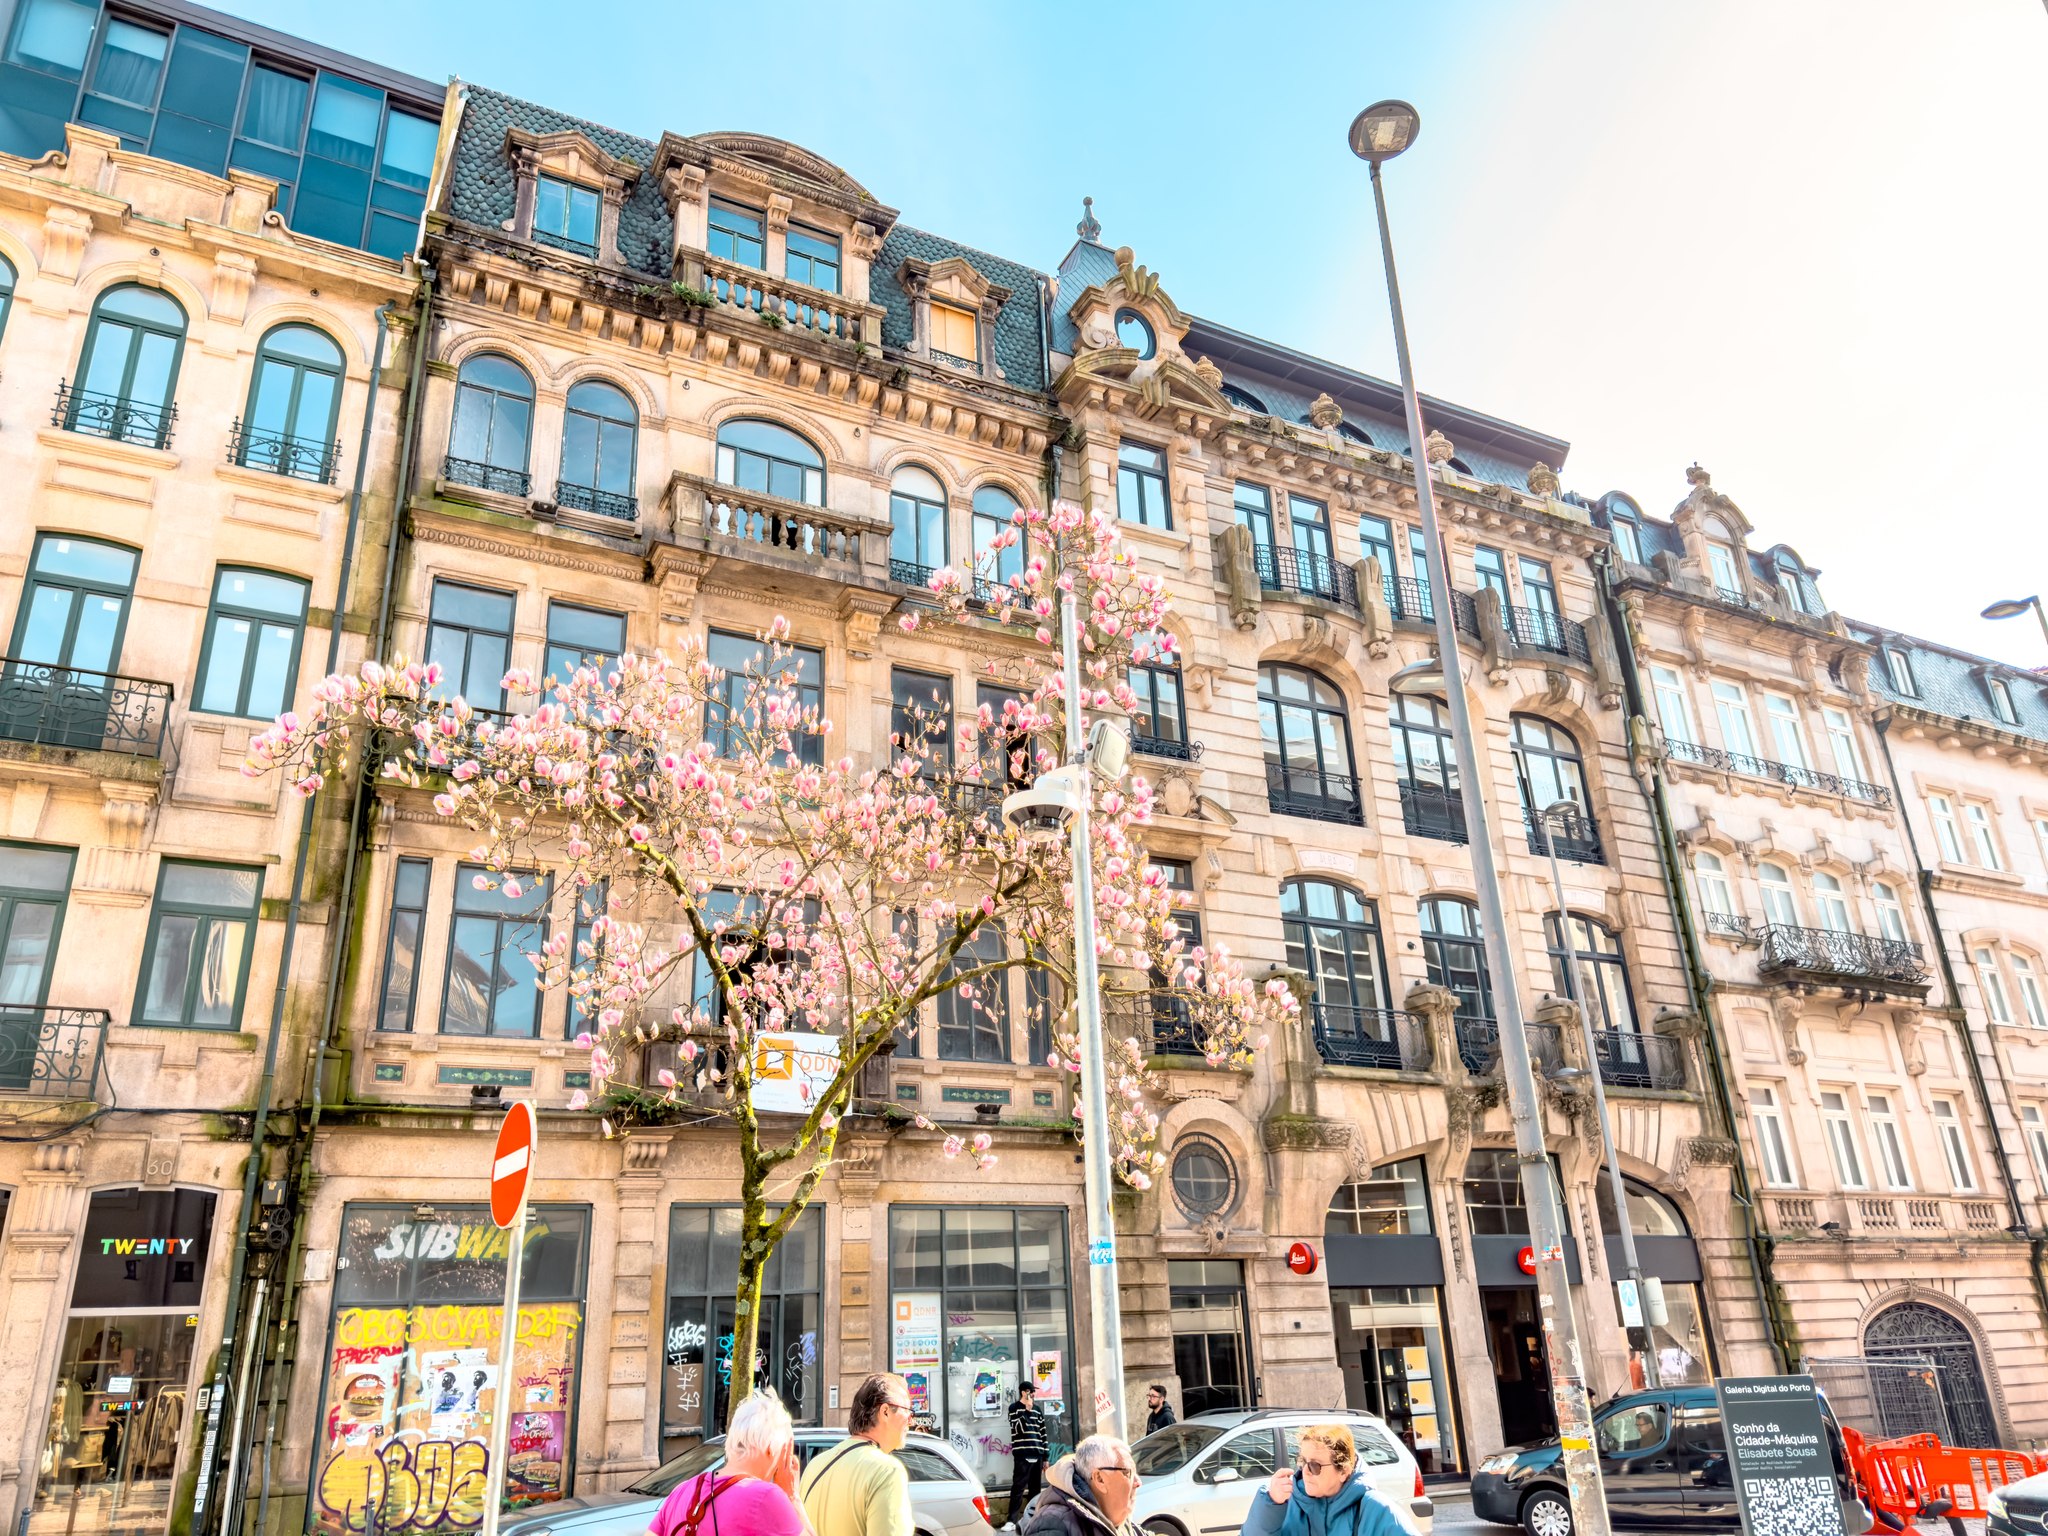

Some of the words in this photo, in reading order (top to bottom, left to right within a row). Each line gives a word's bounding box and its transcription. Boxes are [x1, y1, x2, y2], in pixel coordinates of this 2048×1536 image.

[800, 1054, 841, 1073] QDN
[147, 1160, 173, 1176] 60
[101, 1238, 194, 1255] TWENTY
[1725, 1386, 1752, 1394] Galeria
[1753, 1385, 1777, 1394] Digital
[102, 1401, 144, 1411] TWENTY
[1732, 1424, 1765, 1434] Sonho
[1766, 1423, 1780, 1432] da
[1735, 1434, 1818, 1446] Cidade-Máquina
[1738, 1448, 1784, 1459] Elisabete
[1785, 1447, 1817, 1457] Sousa
